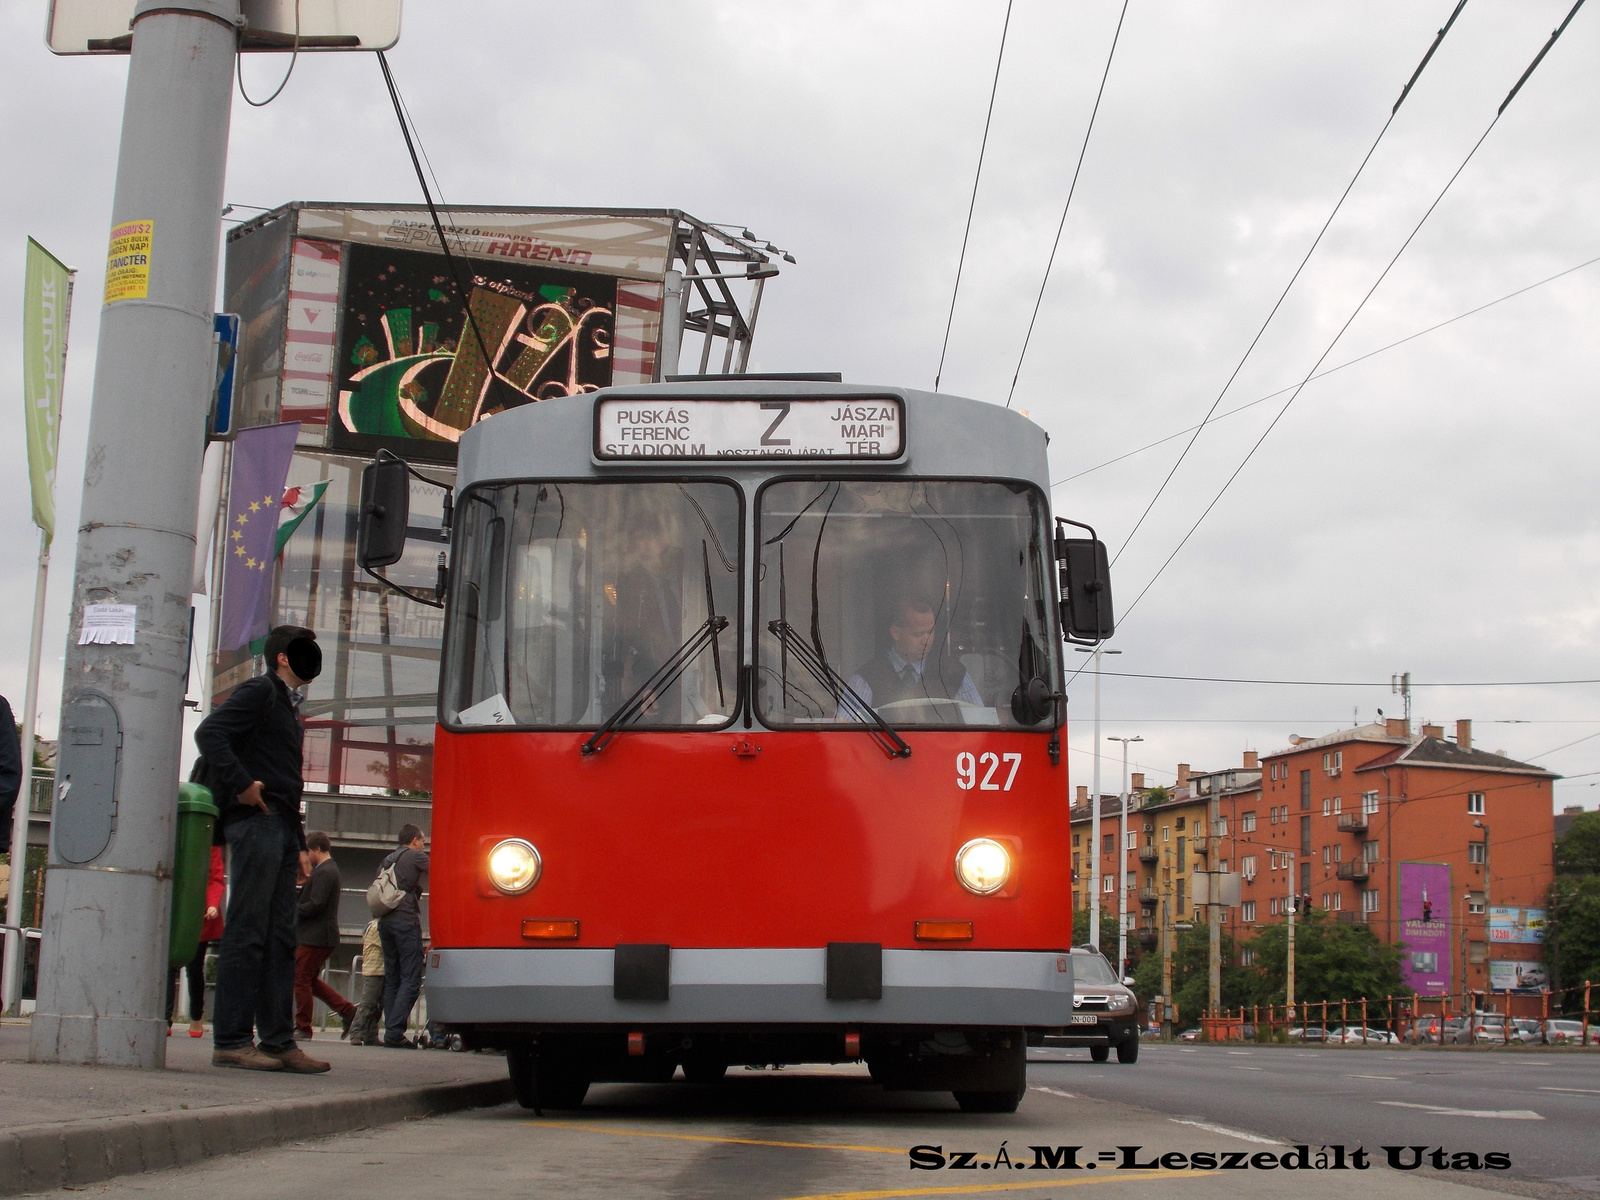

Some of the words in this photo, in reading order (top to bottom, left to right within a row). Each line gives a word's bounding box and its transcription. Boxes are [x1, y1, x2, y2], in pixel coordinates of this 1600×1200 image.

[145, 224, 151, 233] 2
[392, 218, 427, 229] PAPP
[481, 230, 541, 243] BUDAPEST
[129, 242, 149, 251] NAP!
[617, 407, 690, 425] PUSKÁS
[830, 404, 895, 421] JÁSZAI
[759, 402, 791, 446] Z
[841, 424, 885, 438] MARI
[621, 427, 690, 441] FERENC
[605, 443, 682, 455] STADION
[845, 438, 881, 455] TÉR
[956, 751, 1022, 791] 927
[1071, 1015, 1096, 1023] N-009
